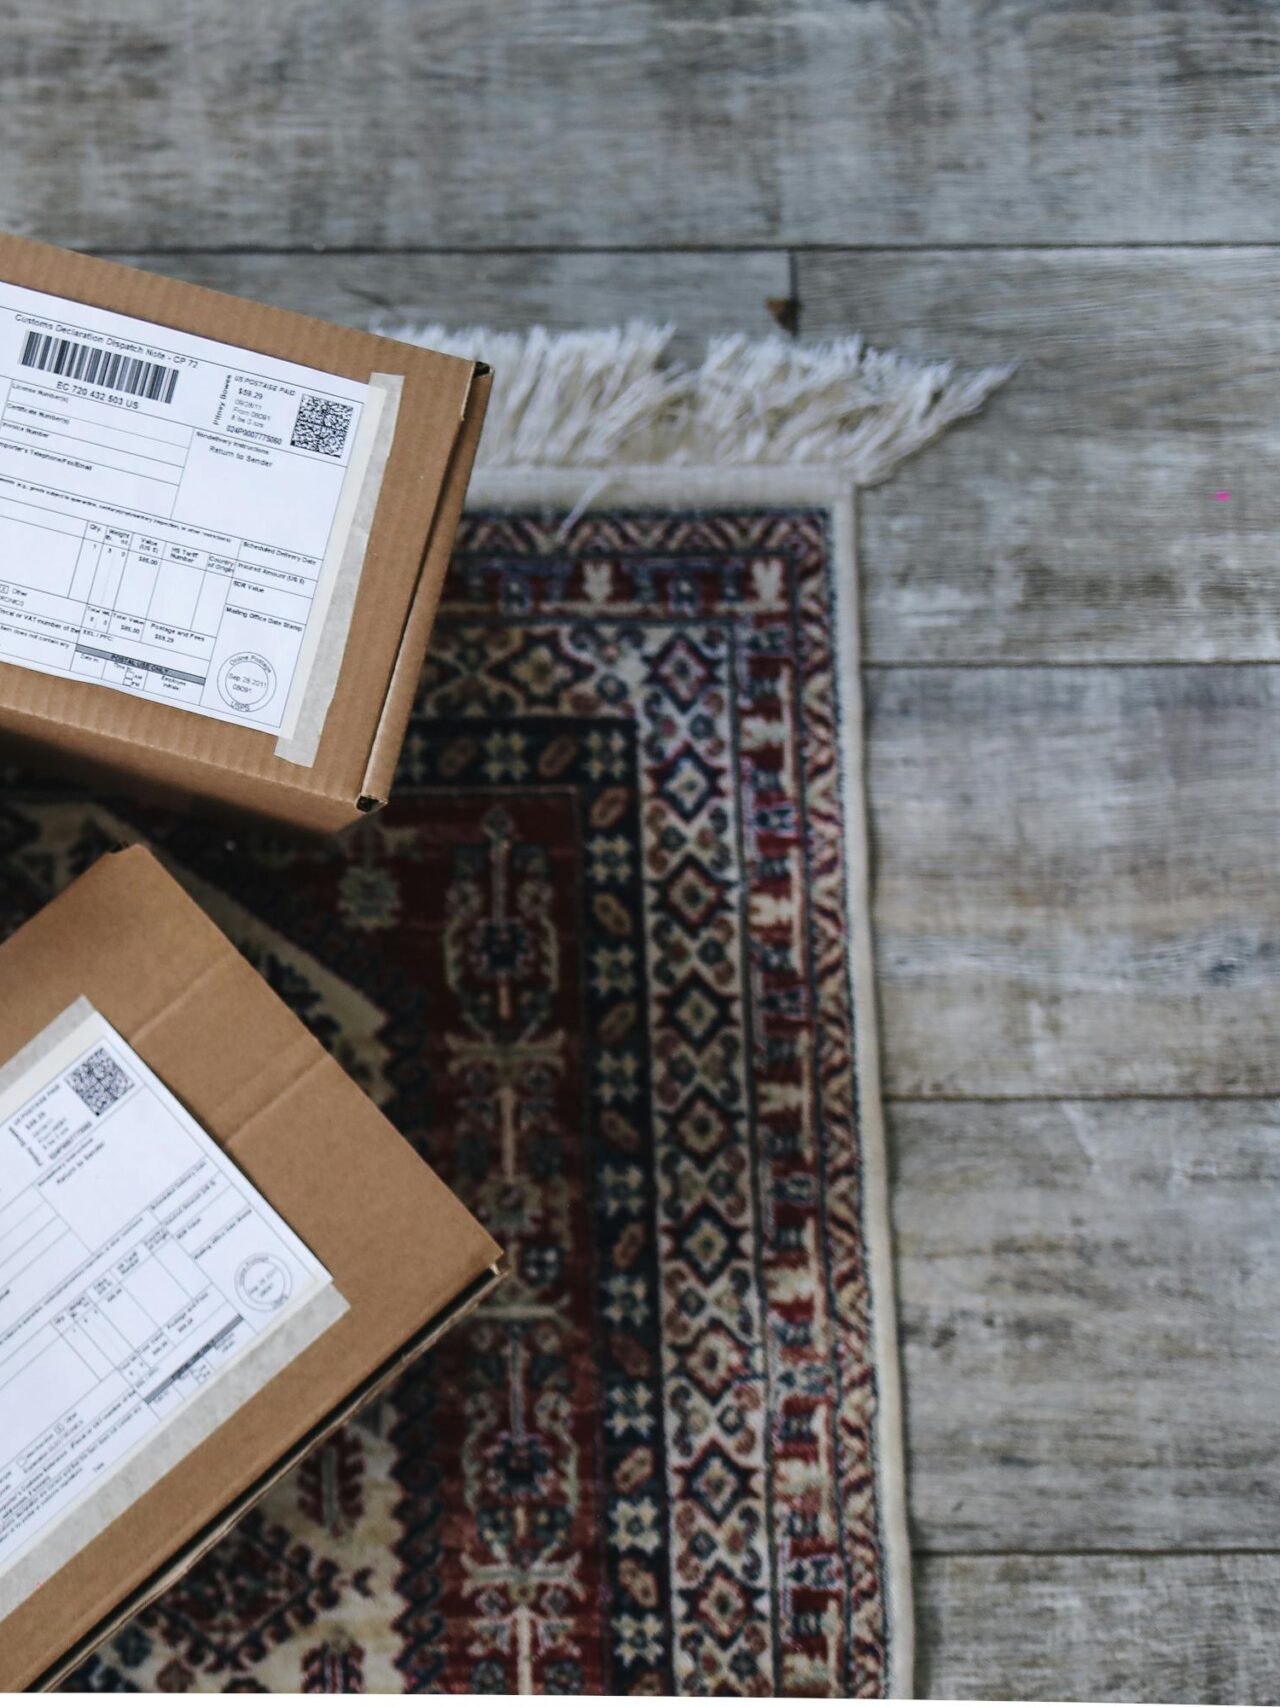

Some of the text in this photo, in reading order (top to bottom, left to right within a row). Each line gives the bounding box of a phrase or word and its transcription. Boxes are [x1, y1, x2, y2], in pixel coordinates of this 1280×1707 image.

[14, 313, 199, 369] Customs Declaration Dispatch Note CP 72
[56, 381, 70, 391] EC
[72, 384, 88, 396] 720
[89, 390, 106, 401] 432
[125, 399, 139, 410] US
[209, 445, 273, 467] Return to Sender
